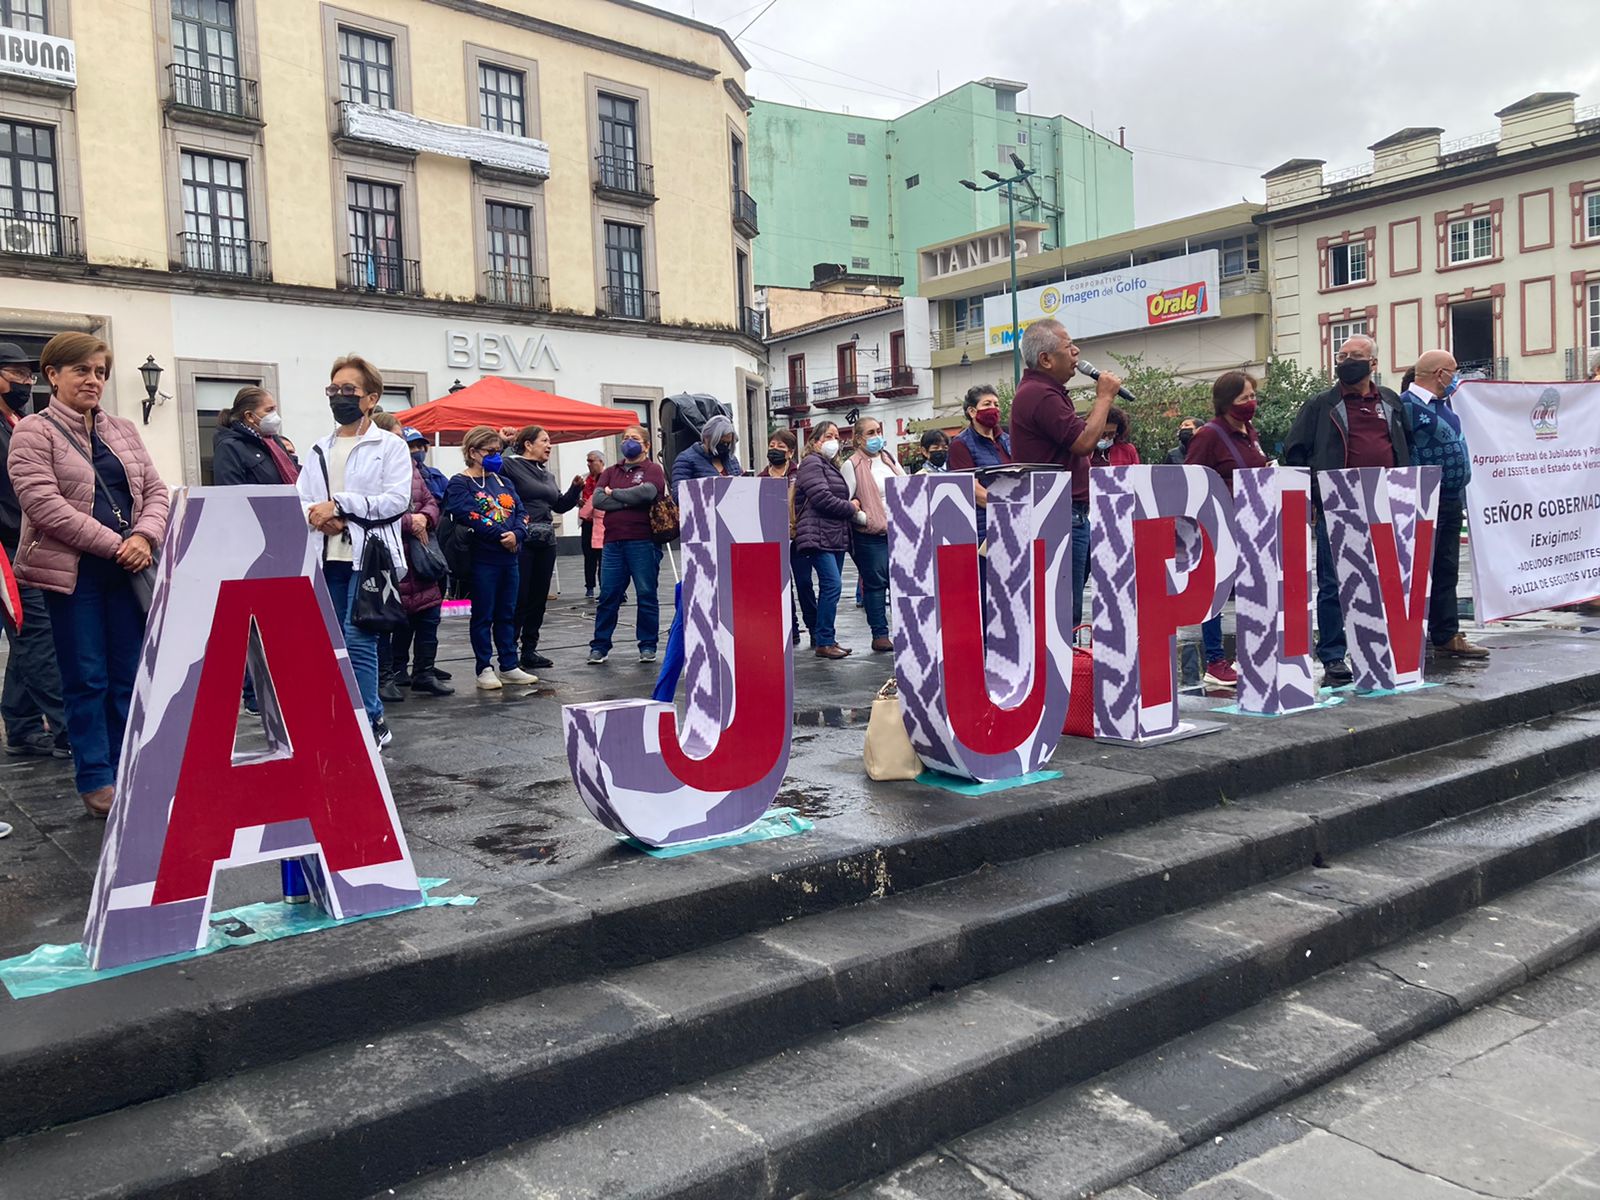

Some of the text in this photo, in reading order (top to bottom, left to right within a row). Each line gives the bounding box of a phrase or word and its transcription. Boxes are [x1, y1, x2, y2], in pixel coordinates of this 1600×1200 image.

[1062, 278, 1147, 304] Imagen del Golfo
[1070, 275, 1122, 291] CORPORATIVO
[446, 330, 561, 372] BBVA
[1516, 451, 1538, 462] Estatal
[1540, 450, 1548, 460] de
[1549, 448, 1582, 459] Jubilados
[1583, 449, 1588, 458] y
[1492, 468, 1506, 478] del
[1508, 466, 1530, 477] ISSSTE
[1531, 467, 1539, 475] en
[1540, 465, 1547, 474] el
[1548, 463, 1571, 473] Estado
[1573, 461, 1581, 471] de
[1483, 493, 1600, 525] SEÑOR GOBERNAD
[1531, 527, 1582, 547] ¡Exigimos!
[1554, 548, 1600, 565] PENDIENTES
[1540, 578, 1549, 589] DE
[1549, 571, 1580, 587] SEGUROS
